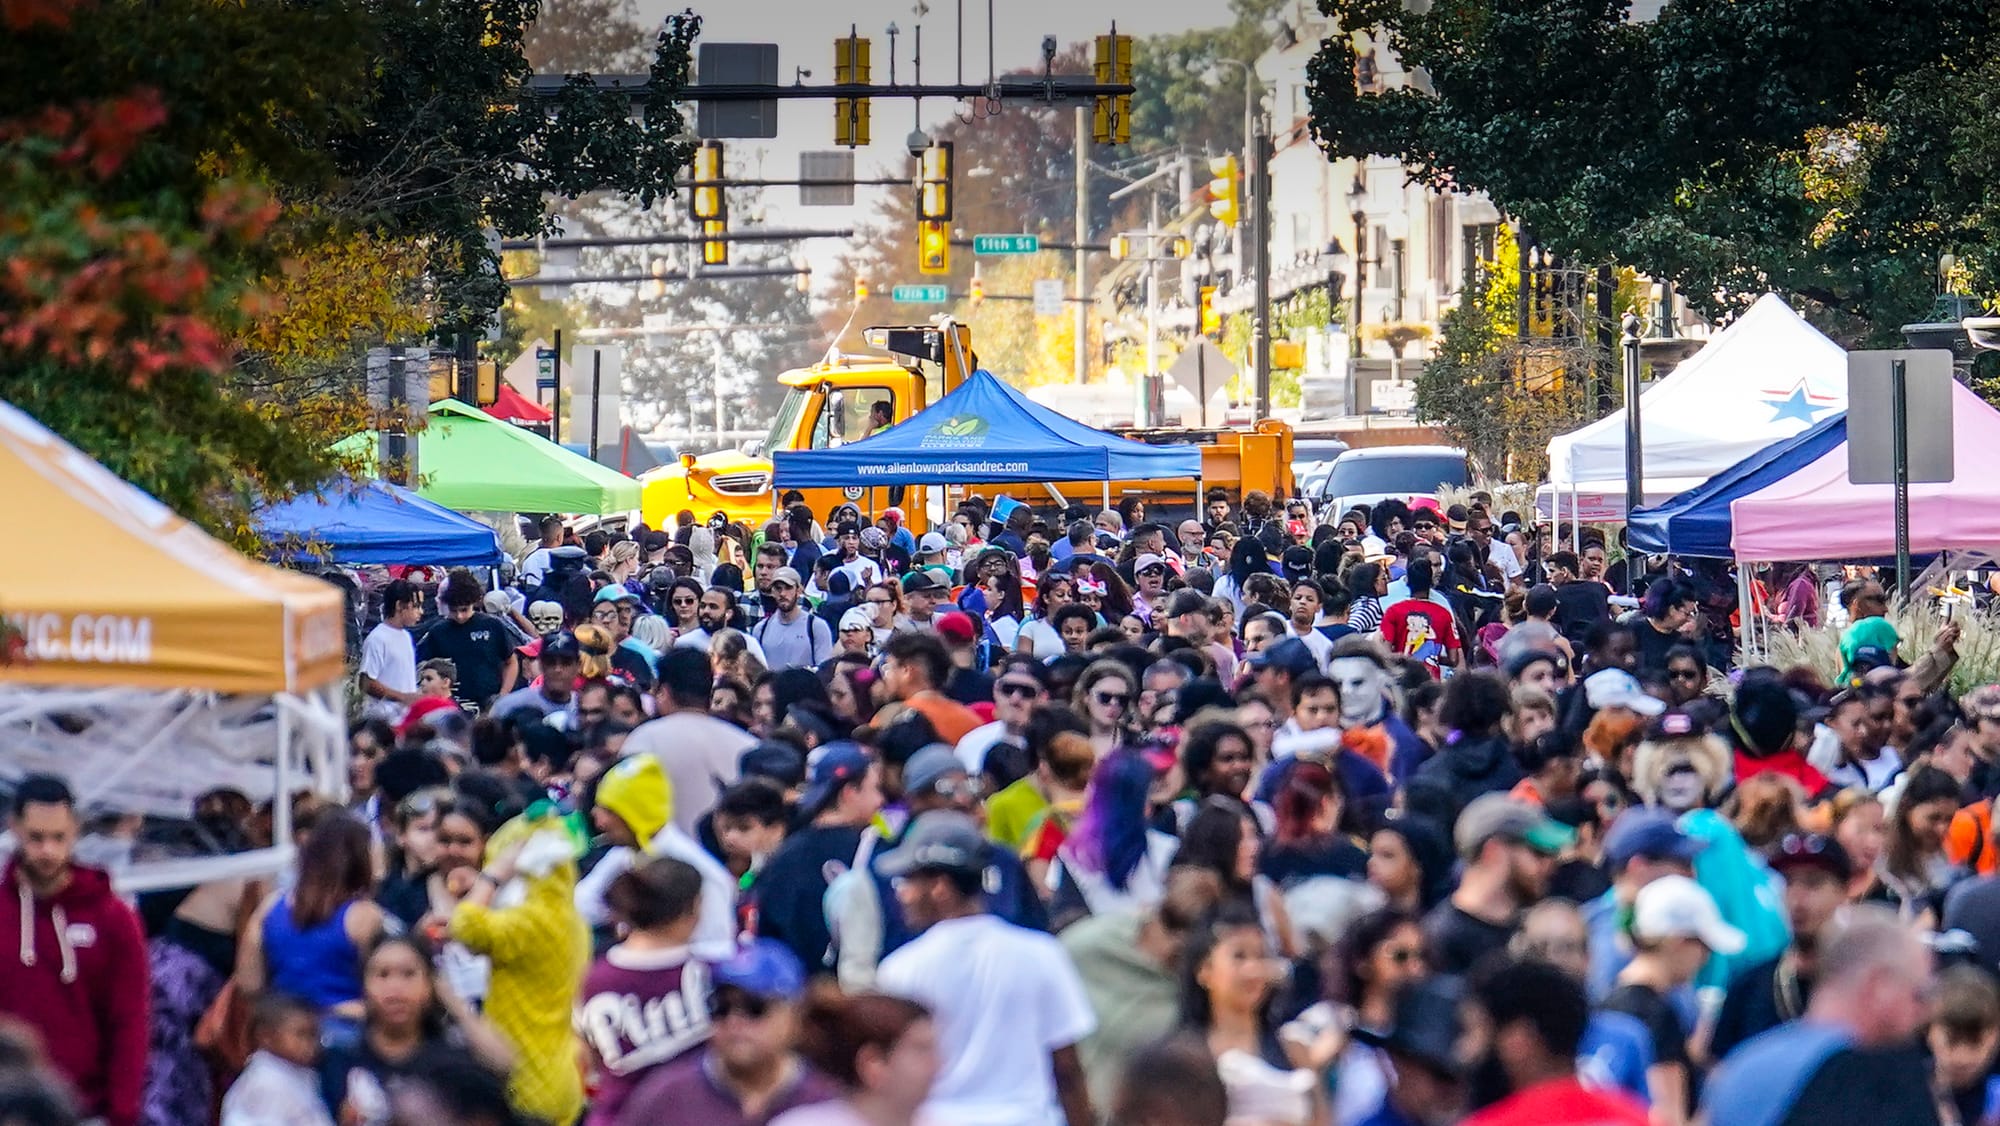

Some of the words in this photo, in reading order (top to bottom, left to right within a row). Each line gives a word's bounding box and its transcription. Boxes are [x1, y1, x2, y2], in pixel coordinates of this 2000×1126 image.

[980, 237, 1009, 251] 11th
[1016, 237, 1032, 250] St
[857, 461, 1028, 475] www.allentownparksandrec.com
